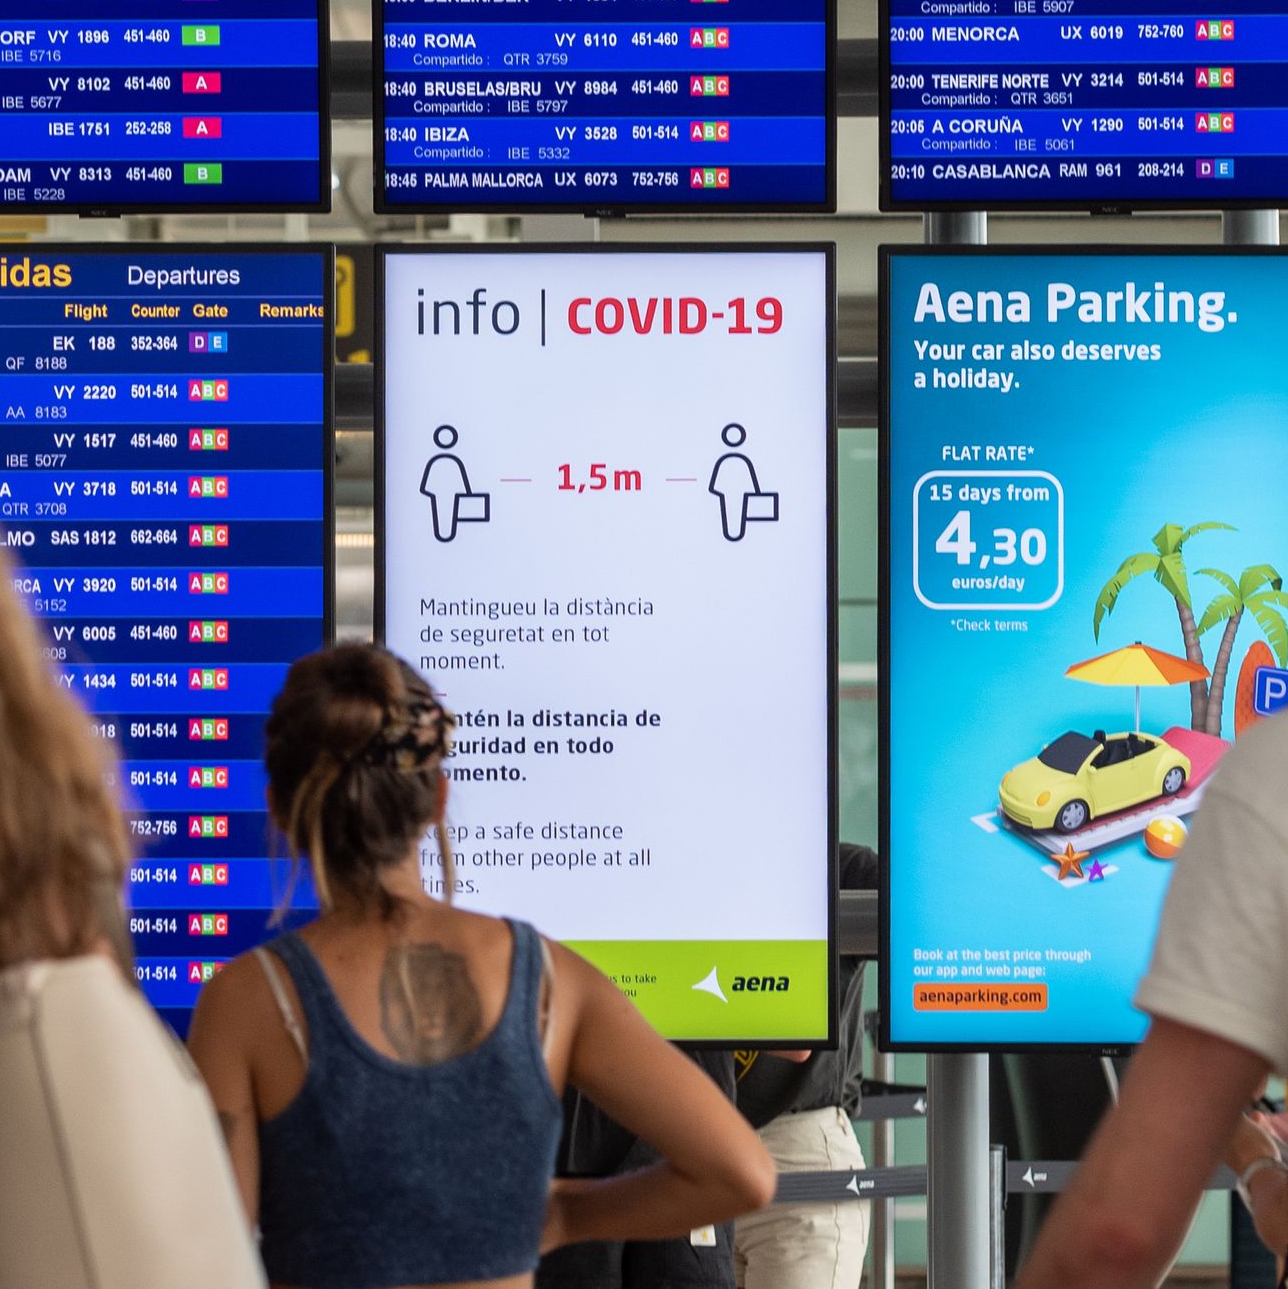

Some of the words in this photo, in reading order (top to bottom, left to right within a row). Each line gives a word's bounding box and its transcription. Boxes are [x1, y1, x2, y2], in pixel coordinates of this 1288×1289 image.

[892, 120, 924, 133] 20:05
[932, 120, 944, 133] A
[949, 116, 1023, 133] CORUÑA
[1062, 119, 1082, 131] VY
[1092, 118, 1123, 131] 1290
[1139, 117, 1184, 130] 501-514
[129, 266, 240, 289] Departures
[418, 289, 519, 335] info
[568, 298, 782, 334] COVID-19
[914, 283, 1030, 322] Aena
[1048, 282, 1237, 332] Parking.
[54, 336, 75, 350] EK
[89, 336, 115, 350] 188
[132, 336, 177, 350] 352-364
[914, 341, 965, 360] Your
[972, 344, 1004, 360] car
[1011, 340, 1054, 360] also
[1062, 340, 1161, 360] deserves
[914, 373, 926, 388] a
[934, 368, 1019, 392] holiday.
[943, 446, 981, 460] FLAT
[931, 485, 952, 500] 15
[959, 484, 1001, 504] days
[1007, 484, 1049, 501] from
[936, 511, 1046, 569] 4,30
[952, 575, 1025, 592] euros/day
[421, 599, 535, 619] Mantingueu
[545, 599, 558, 615] la
[567, 598, 653, 615] distància
[995, 620, 1028, 631] terms
[421, 626, 443, 642] de
[451, 627, 543, 646] seguretat
[552, 629, 574, 641] en
[584, 627, 607, 641] tot
[420, 653, 504, 669] moment.
[455, 710, 500, 727] ntén
[507, 710, 524, 726] la
[532, 710, 628, 727] distancia
[636, 710, 661, 727] de
[448, 737, 526, 758] guridad
[534, 740, 559, 753] en
[567, 737, 614, 753] todo
[475, 826, 485, 839] a
[493, 822, 534, 839] safe
[541, 822, 623, 839] distance
[472, 849, 524, 866] other
[531, 849, 596, 869] people
[604, 851, 621, 866] at
[629, 849, 651, 866] all
[914, 949, 942, 960] Book
[947, 950, 958, 960] at
[963, 949, 981, 960] the
[985, 949, 1010, 960] best
[1014, 949, 1041, 963] price
[1045, 949, 1091, 963] through
[621, 975, 631, 983] to
[635, 974, 656, 983] take
[914, 966, 932, 975] our
[937, 966, 958, 978] app
[961, 965, 982, 975] and
[986, 965, 1010, 975] web
[732, 977, 789, 991] aena
[920, 990, 1041, 1005] aenaparking.com
